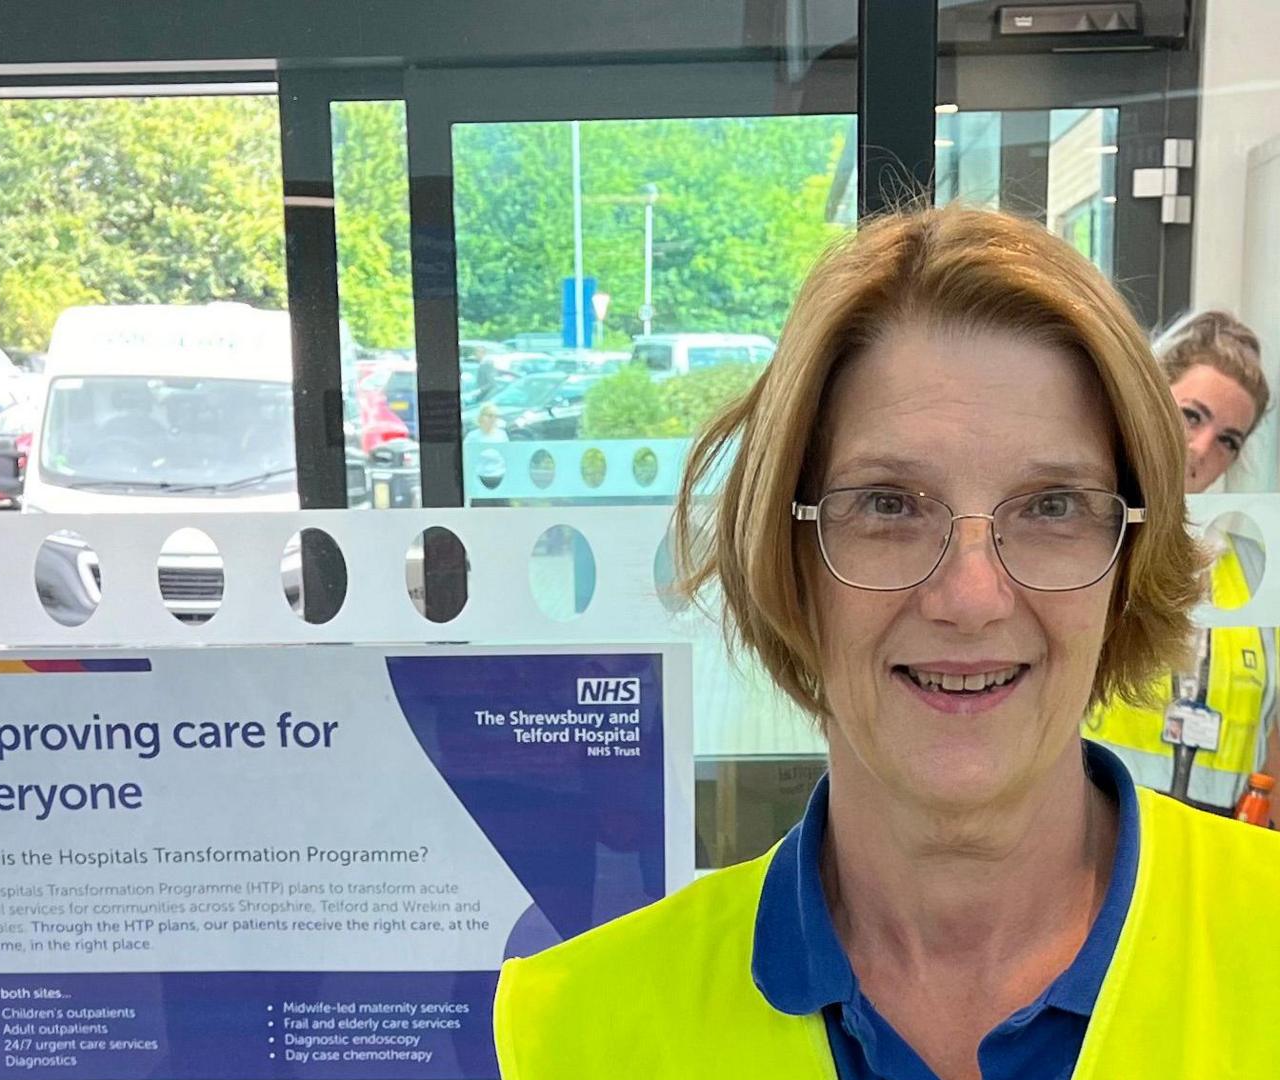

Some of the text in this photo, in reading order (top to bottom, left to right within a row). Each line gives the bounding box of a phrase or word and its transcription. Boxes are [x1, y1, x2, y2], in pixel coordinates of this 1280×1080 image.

[582, 680, 636, 702] NHS
[474, 708, 639, 729] The Shrewsbury and
[173, 721, 266, 749] care
[276, 711, 339, 748] for
[513, 726, 640, 745] Telford Hospital
[587, 746, 640, 756] NHS Trust
[2, 850, 15, 866] is
[21, 849, 52, 865] the
[59, 848, 148, 868] Hospitals
[153, 846, 300, 863] Transformation
[307, 846, 428, 867] Programme?
[31, 940, 43, 951] in
[47, 939, 71, 951] the
[75, 938, 108, 954] right
[0, 988, 31, 999] both
[1, 1007, 136, 1020] Children's outpatients
[283, 1001, 470, 1016] Midwife-led maternity services
[3, 1023, 108, 1037] Adult outpatients
[284, 1015, 461, 1032] Frail and elderly care services
[4, 1039, 158, 1053] 24/7 urgent care services
[284, 1033, 421, 1048] Diagnostic endoscopy
[5, 1055, 77, 1069] Diagnostics
[285, 1047, 432, 1064] Day case chemotherapy
